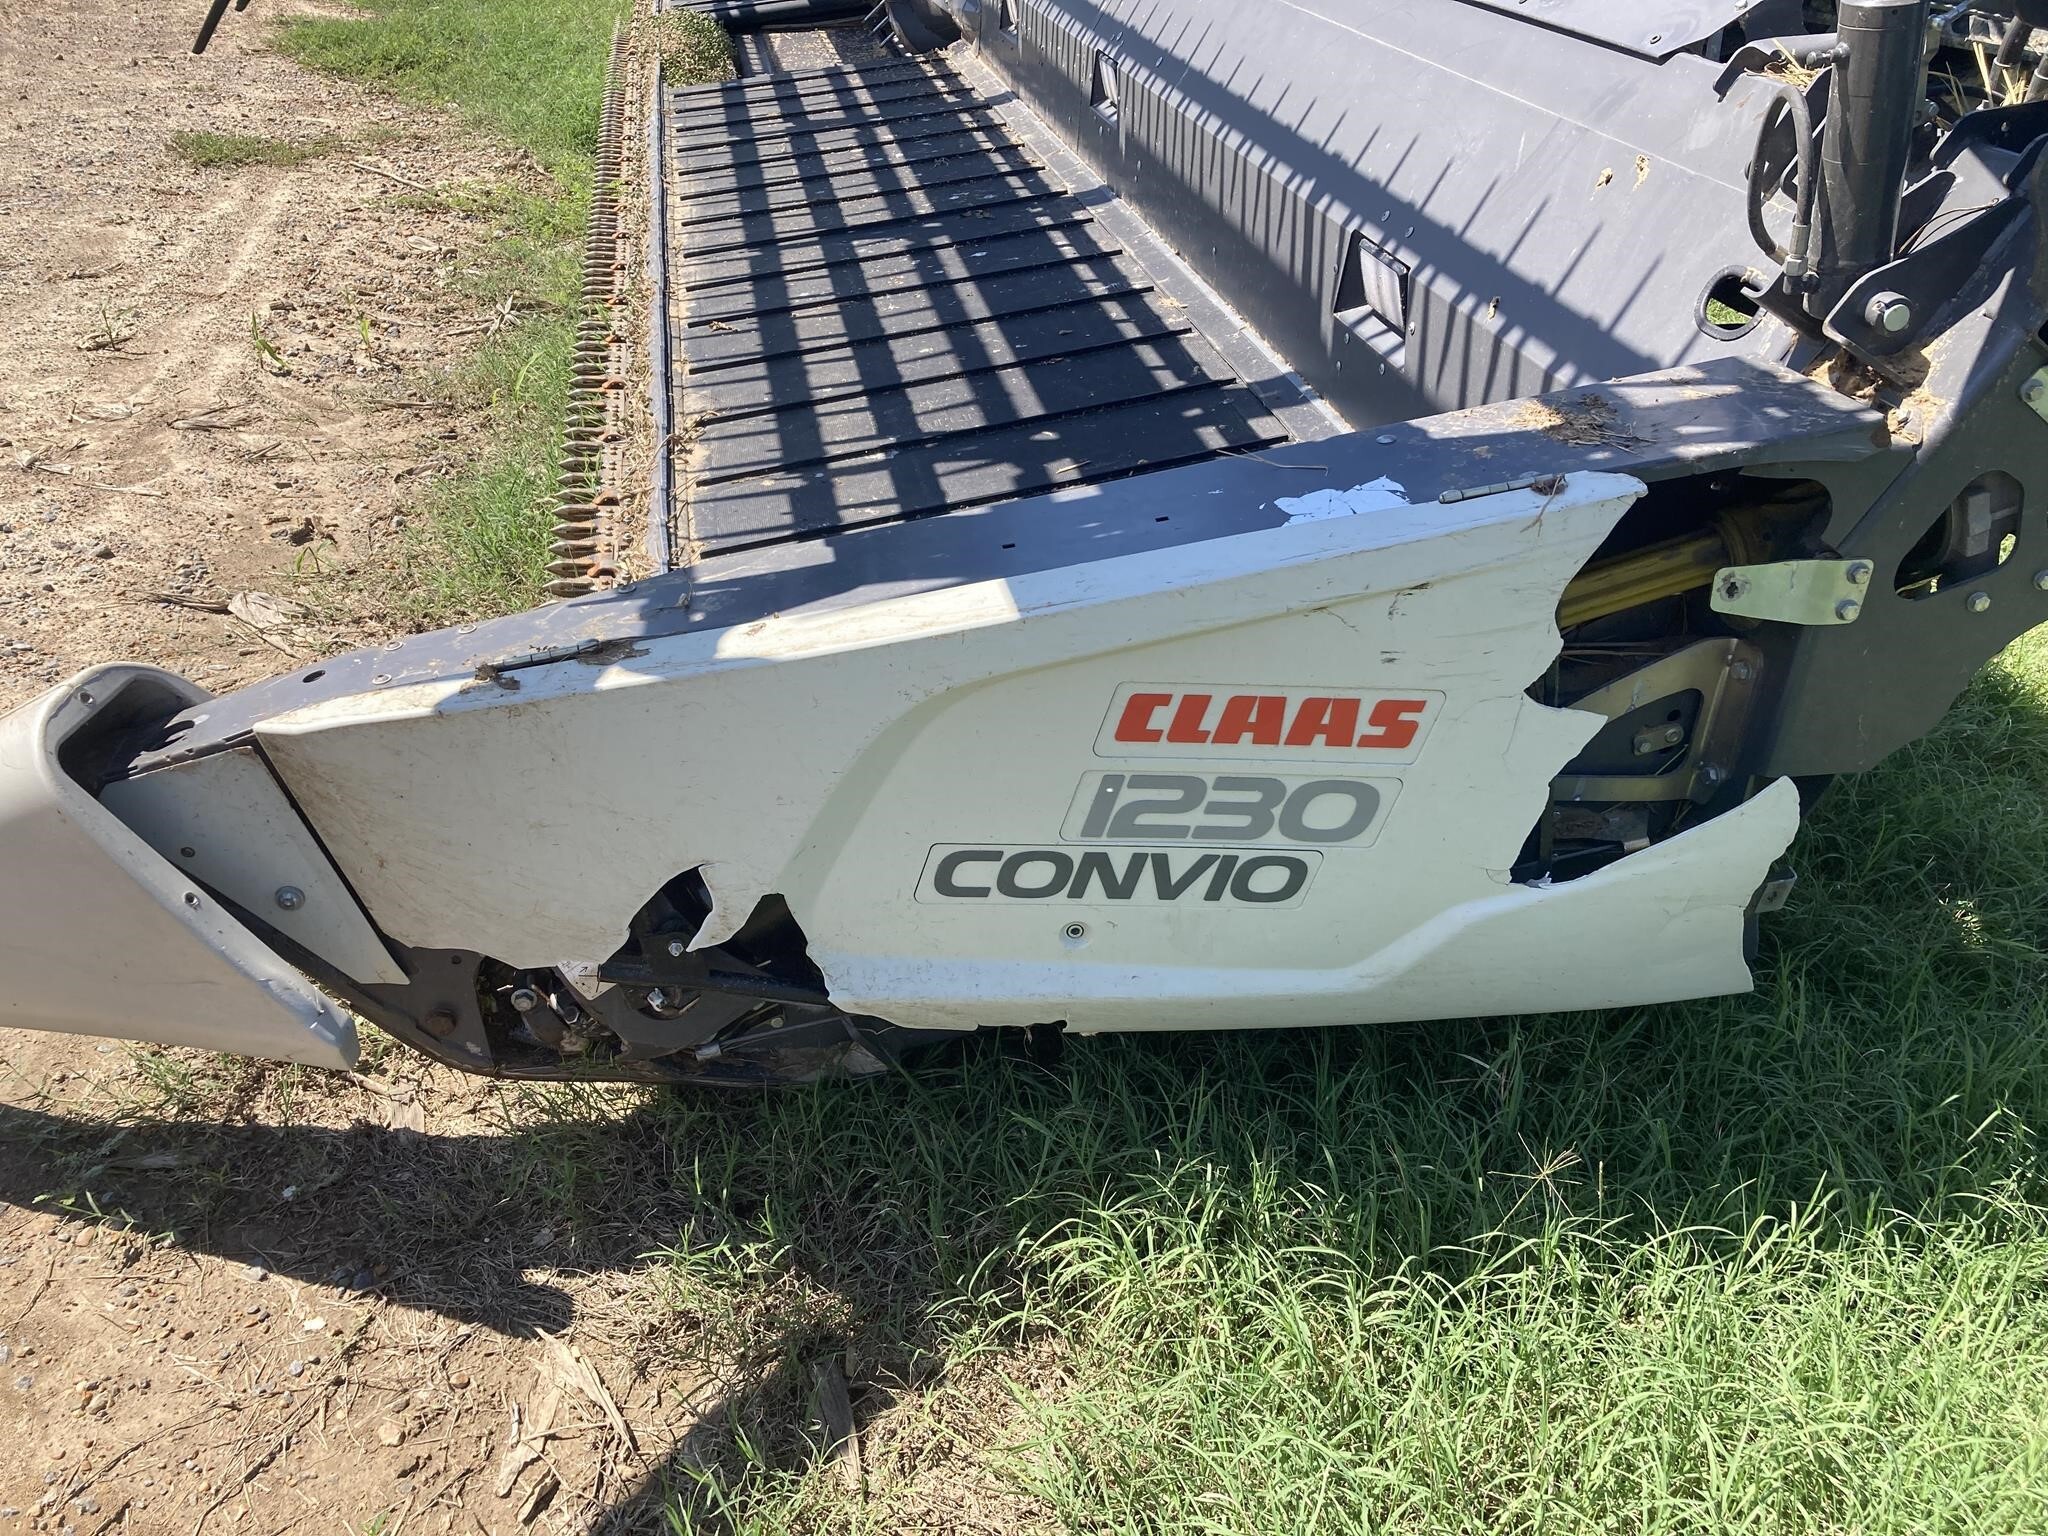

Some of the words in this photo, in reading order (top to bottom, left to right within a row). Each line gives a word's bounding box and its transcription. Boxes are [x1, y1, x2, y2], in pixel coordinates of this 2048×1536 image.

[1114, 693, 1427, 748] CLAAS
[1080, 774, 1381, 843] 1230
[933, 850, 1309, 903] CONVIO
